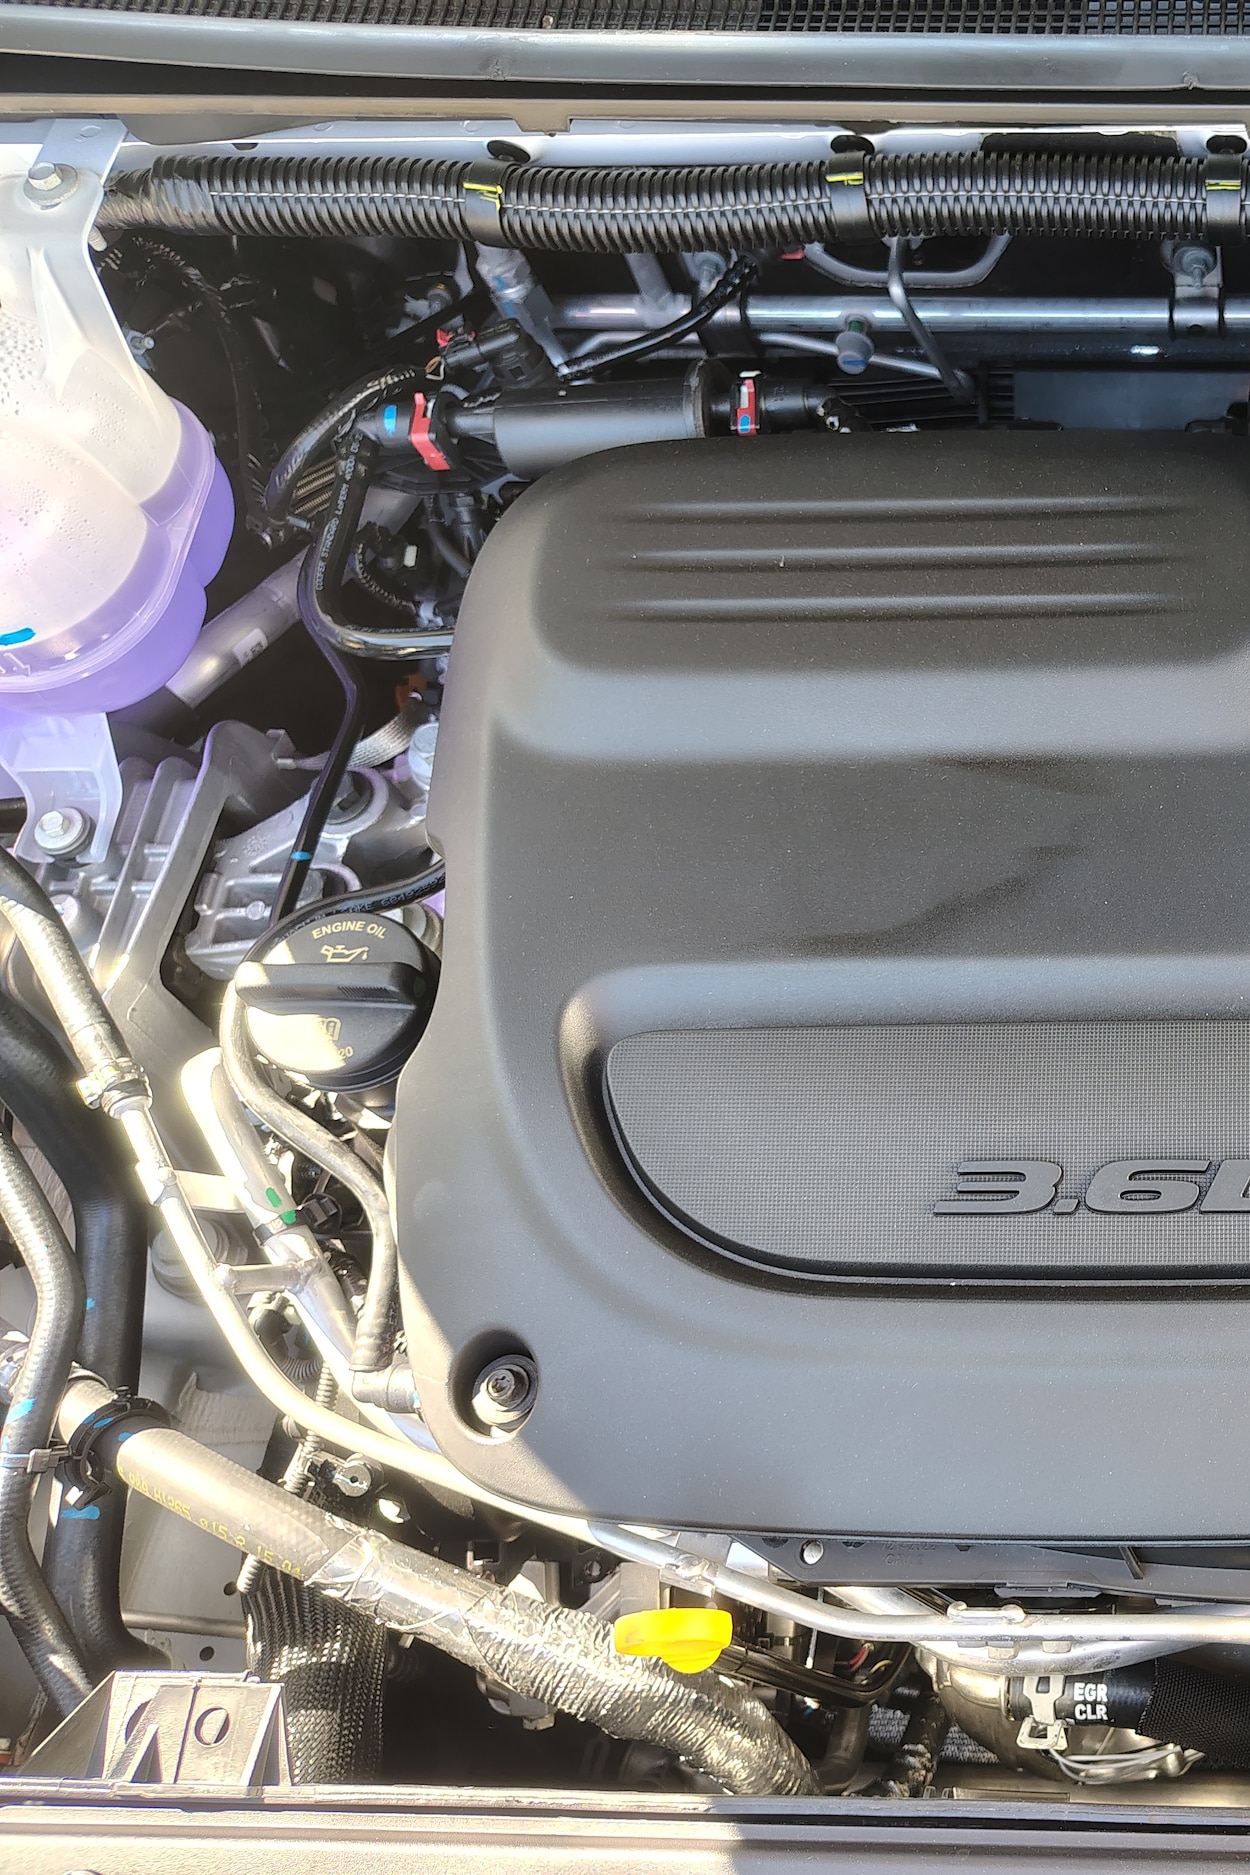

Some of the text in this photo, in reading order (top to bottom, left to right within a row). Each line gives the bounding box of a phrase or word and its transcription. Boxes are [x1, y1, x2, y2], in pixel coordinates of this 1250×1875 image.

[311, 920, 366, 940] ENGINE
[366, 923, 388, 939] OIL
[1073, 1682, 1108, 1702] EGR
[1074, 1703, 1108, 1720] CLR
